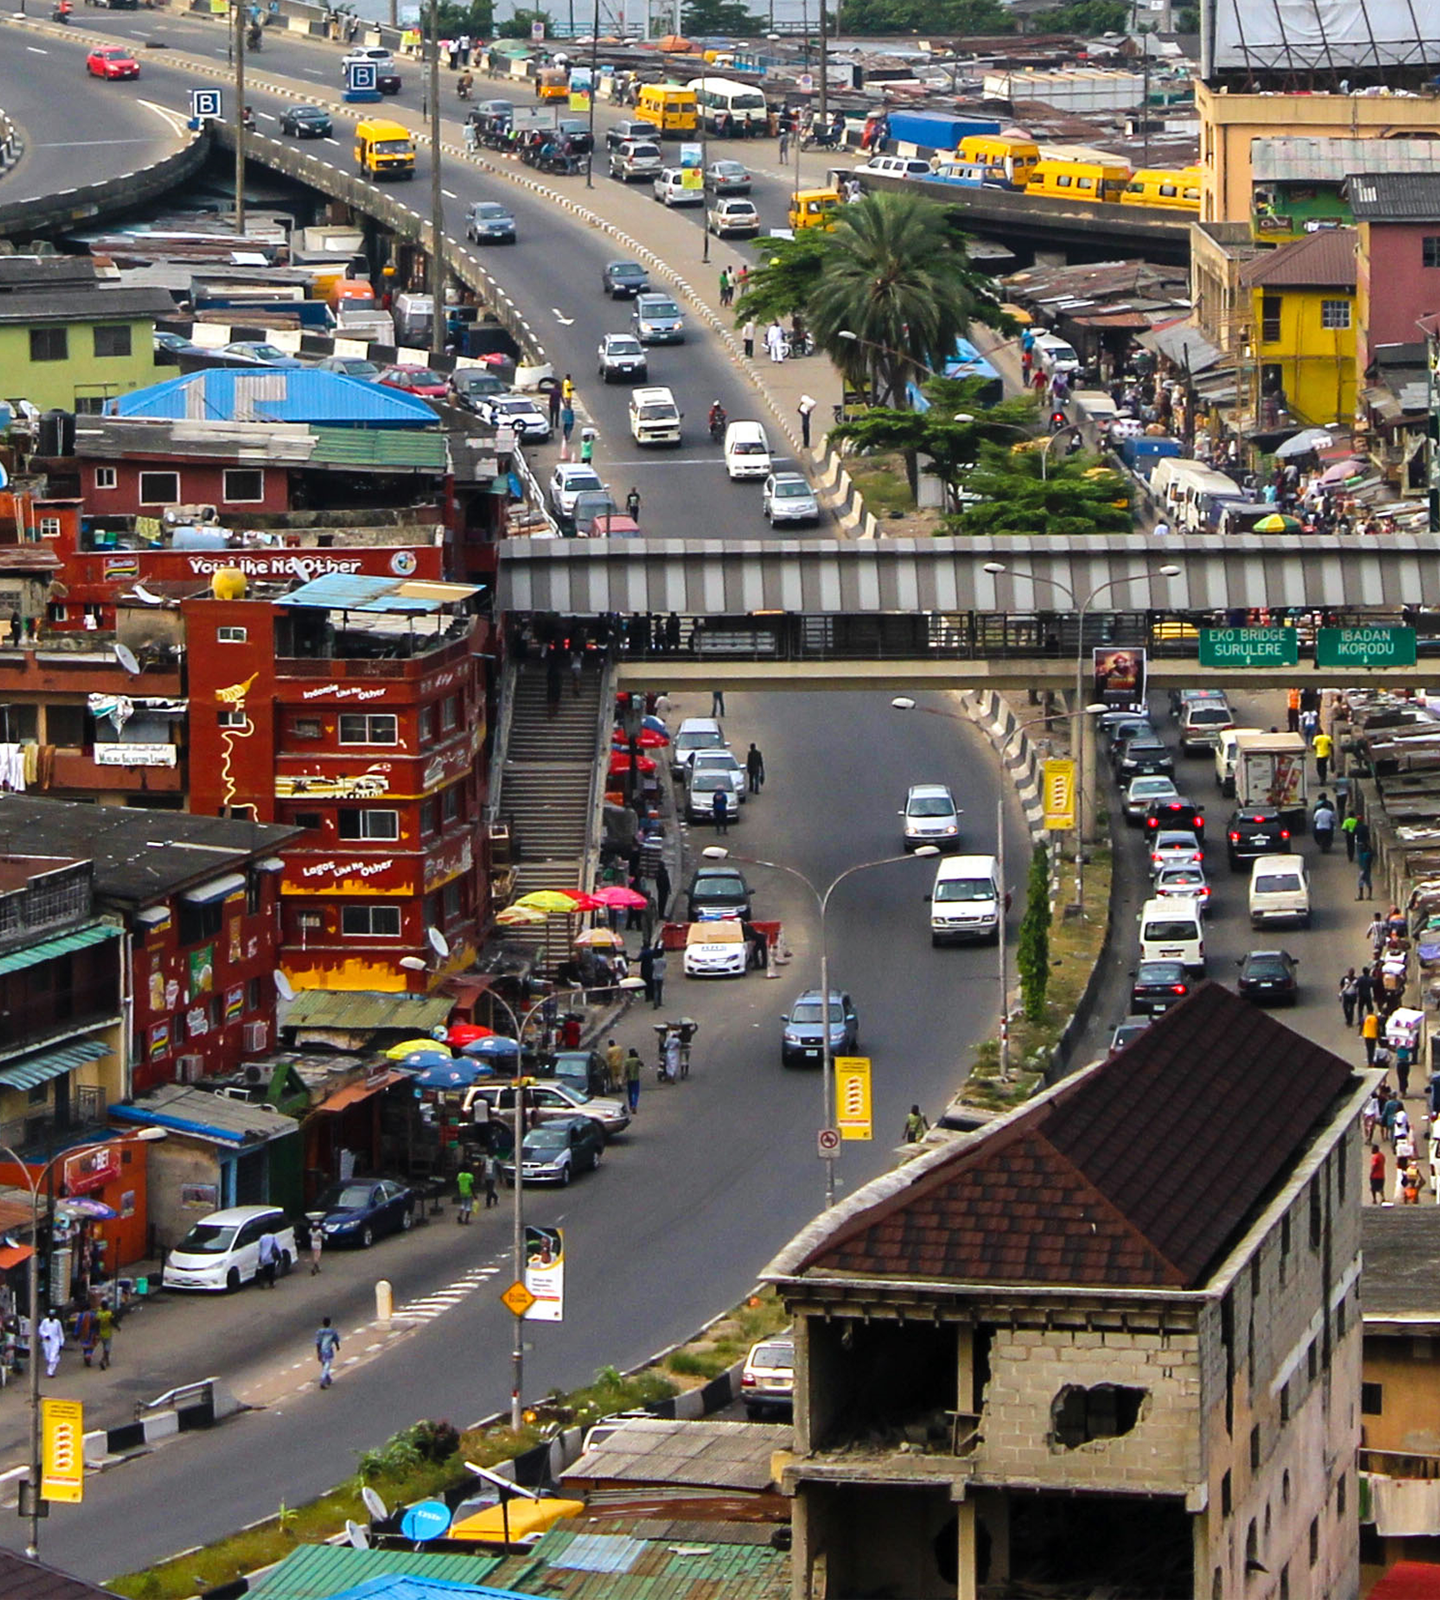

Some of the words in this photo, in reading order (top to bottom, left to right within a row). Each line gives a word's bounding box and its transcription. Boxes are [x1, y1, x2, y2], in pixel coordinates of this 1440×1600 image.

[357, 68, 370, 85] B
[200, 95, 214, 112] B
[189, 559, 223, 574] You
[303, 559, 361, 574] Other
[1209, 631, 1234, 642] EKO
[1240, 629, 1287, 642] BRIDGE
[1341, 629, 1391, 642] IBADAN
[1214, 643, 1282, 656] SURULERE
[1338, 643, 1395, 655] IKORODU
[358, 687, 387, 701] Other
[302, 860, 337, 877] Lagos
[360, 859, 394, 877] Other
